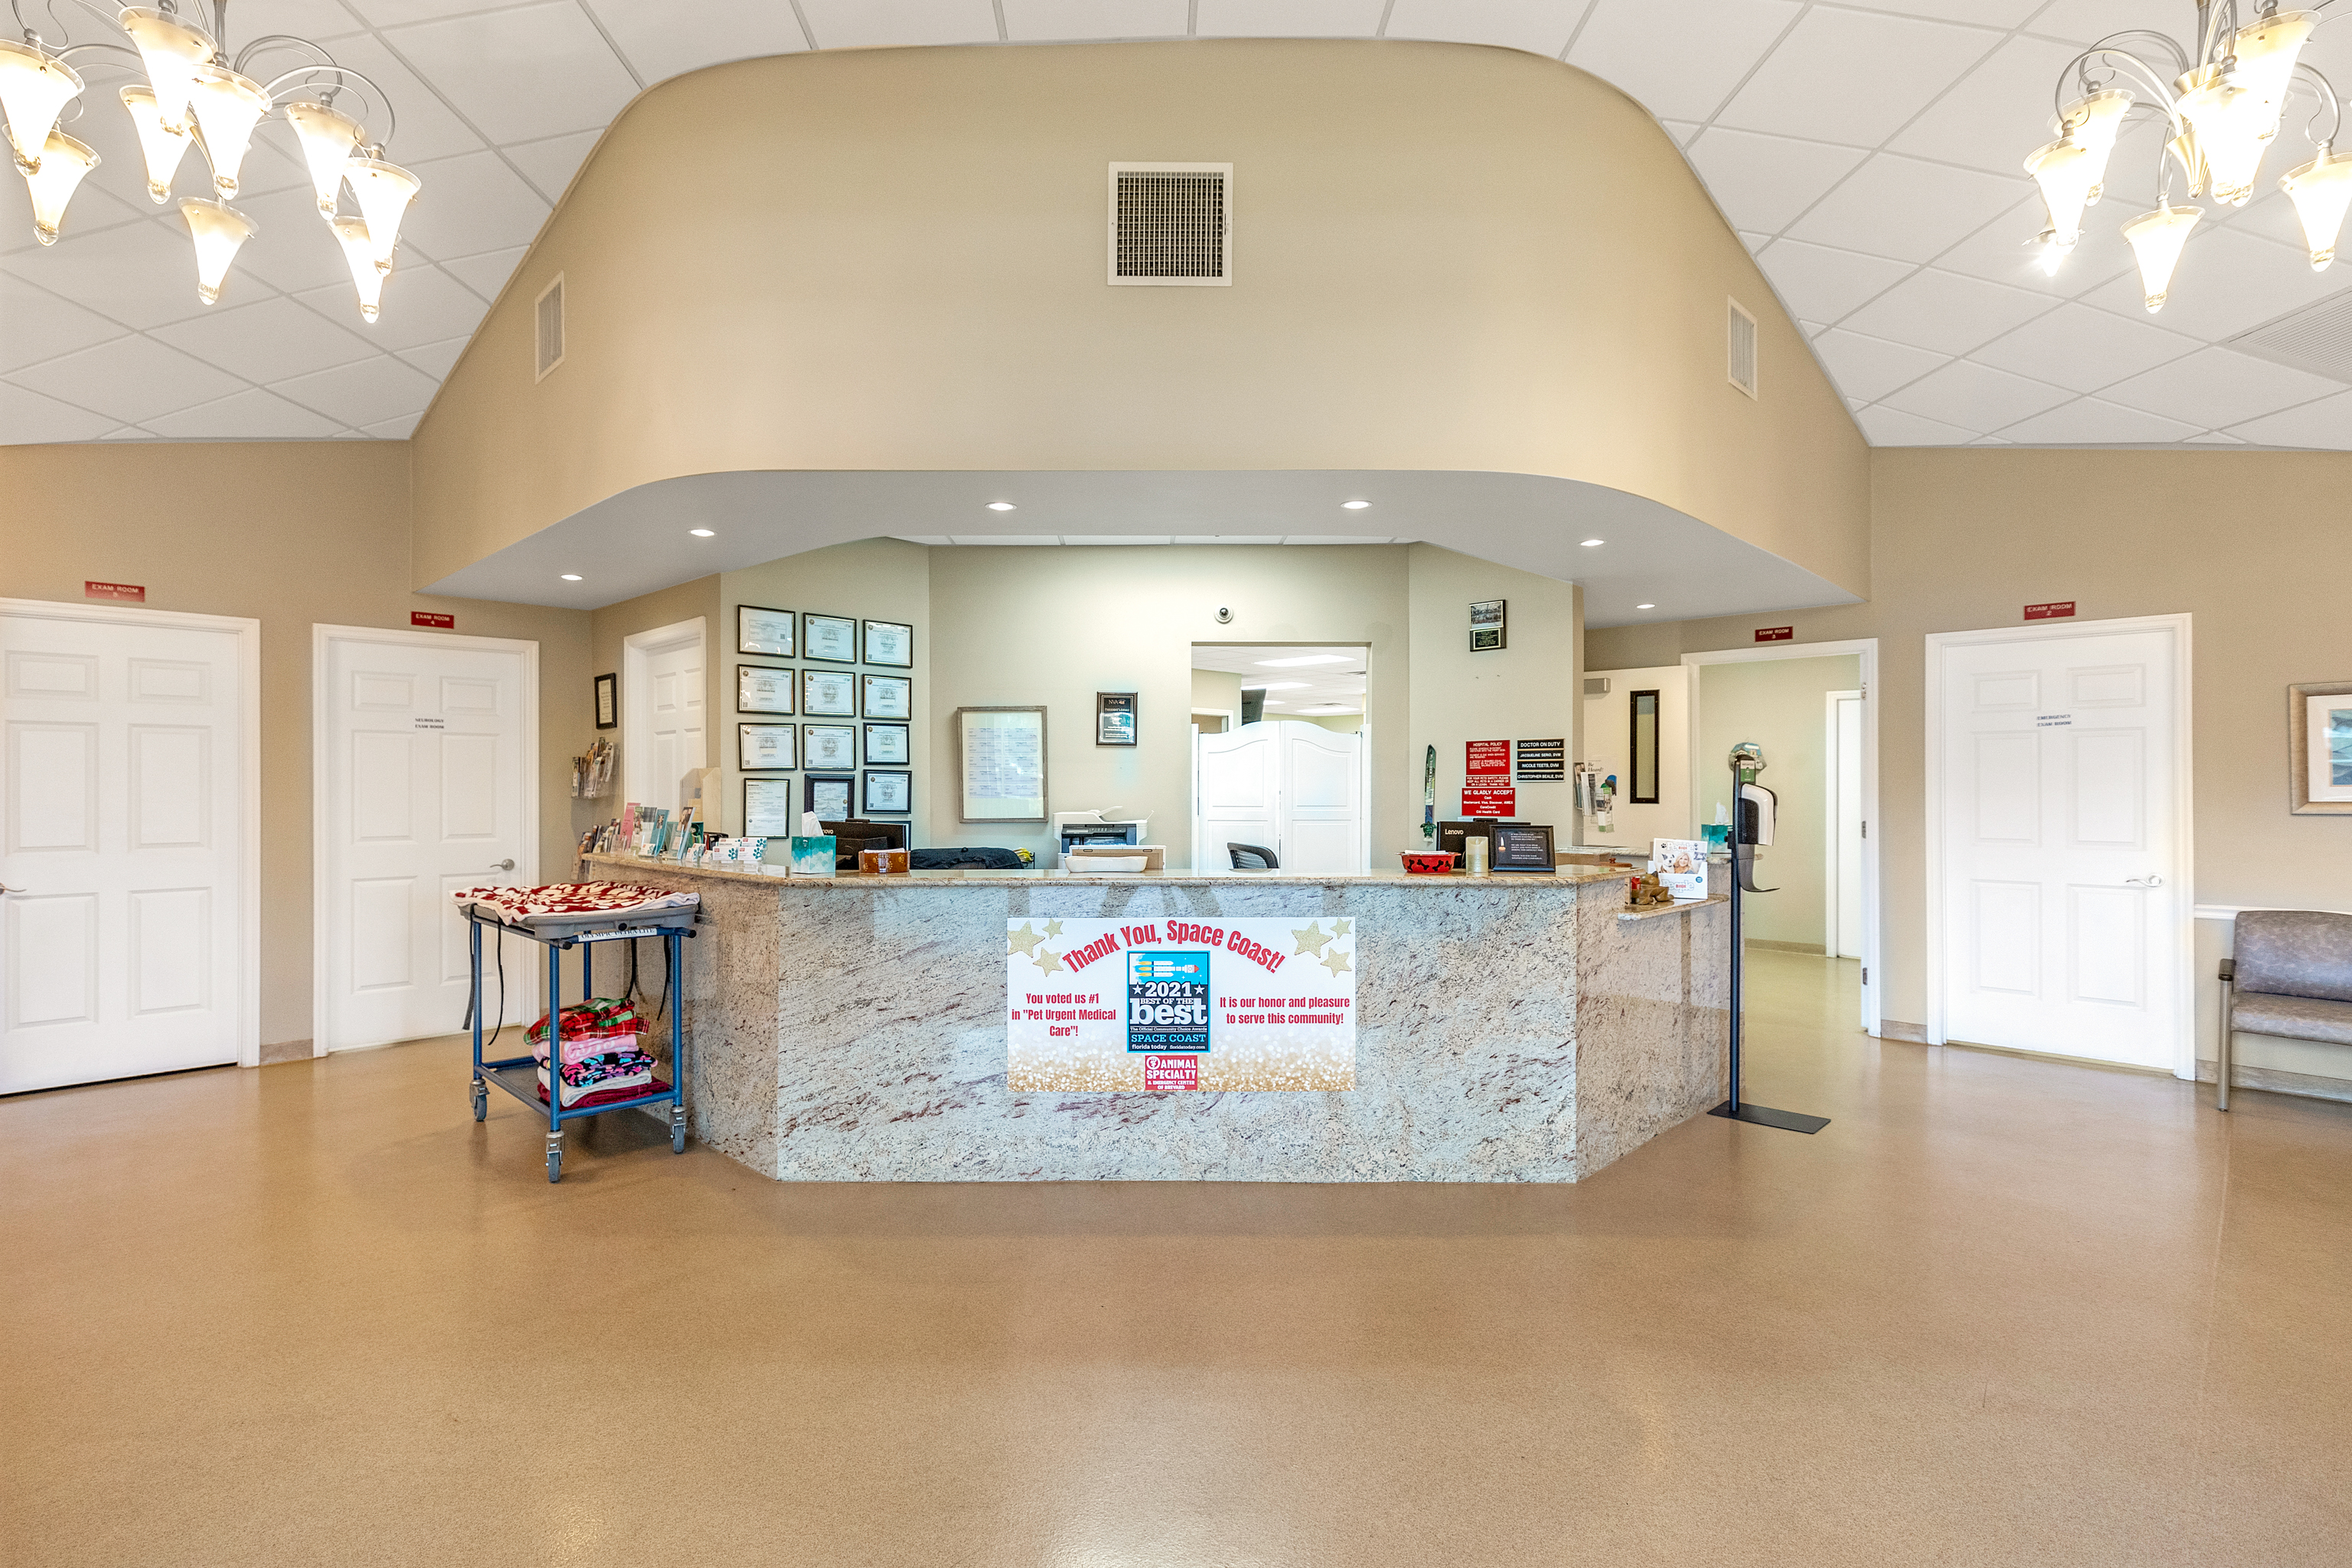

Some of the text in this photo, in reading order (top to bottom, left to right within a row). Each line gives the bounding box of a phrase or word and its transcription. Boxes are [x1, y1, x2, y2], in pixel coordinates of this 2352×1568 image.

[581, 931, 612, 939] OLYMPIC
[1062, 920, 1286, 974] Thank You, Space Coast!
[1145, 982, 1192, 998] 2021
[1026, 993, 1099, 1004] You voted us #1
[1220, 996, 1350, 1009] It is our honor and pleasure
[1011, 1009, 1116, 1021] in "Pet Urgent Medical
[1129, 998, 1208, 1025] best
[1226, 1012, 1344, 1025] to serve this community!
[1049, 1025, 1079, 1037] Care"!
[1160, 1059, 1197, 1069] ANIMAL
[1146, 1070, 1196, 1080] SPECIALTY
